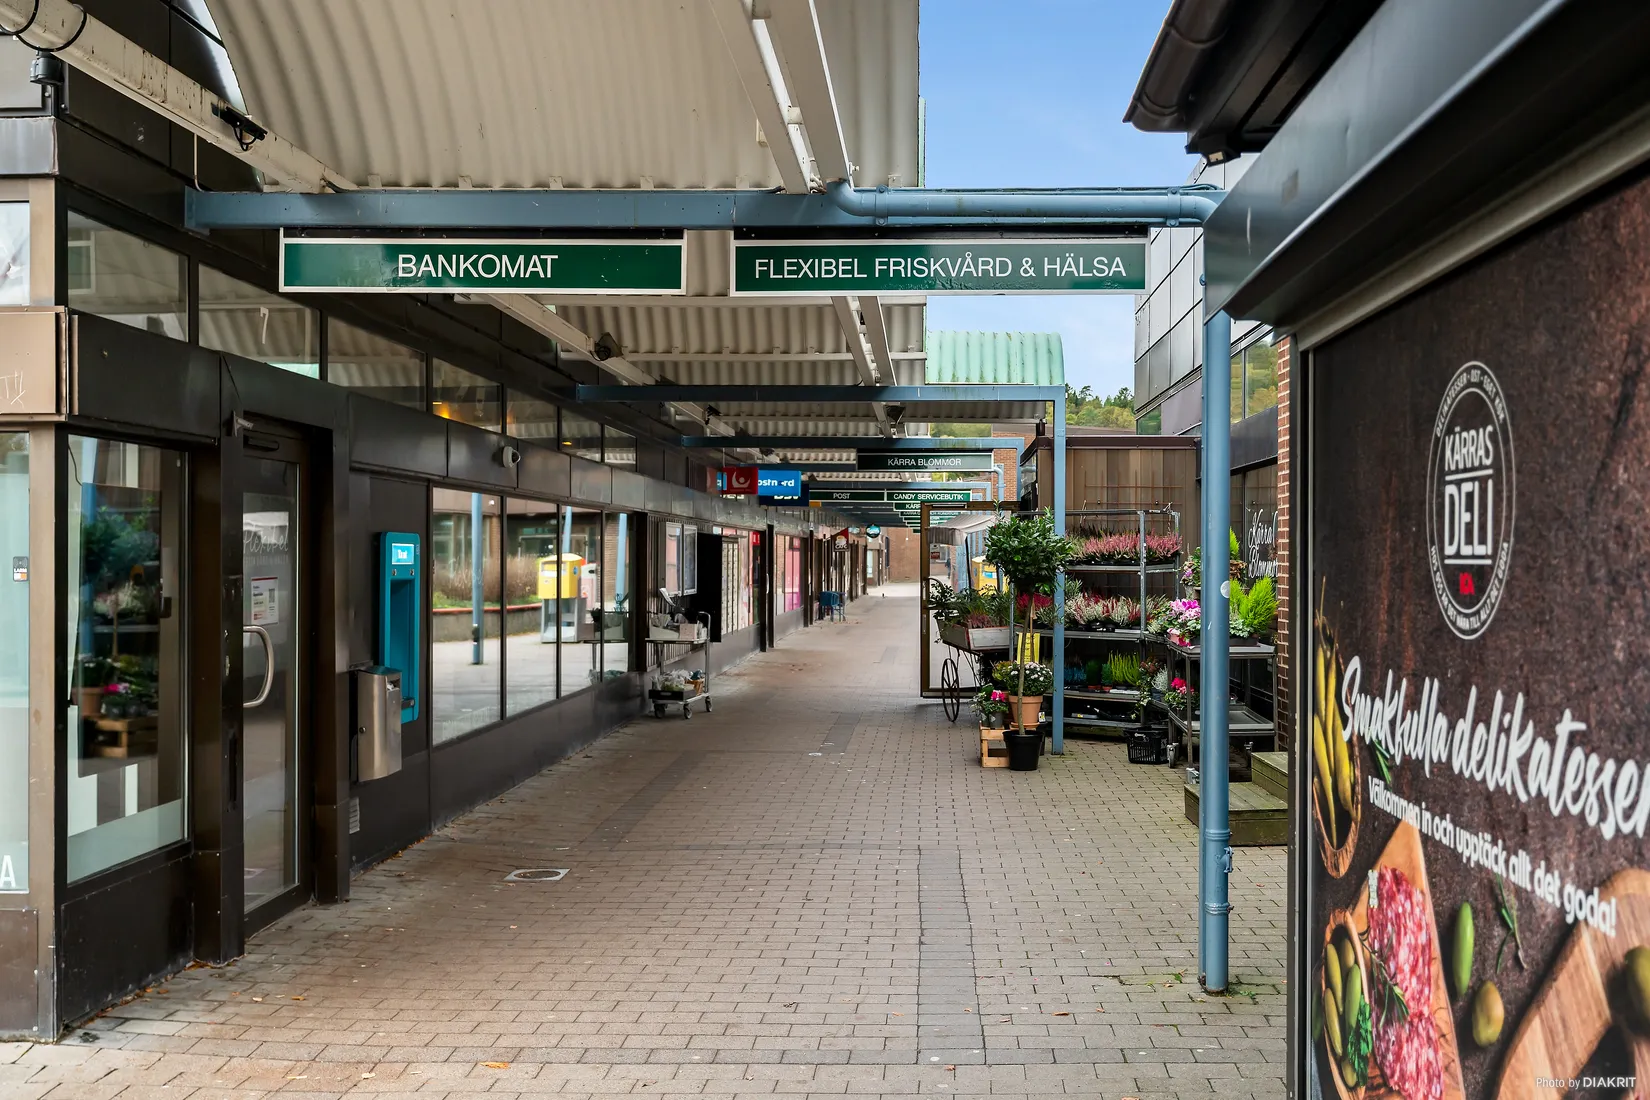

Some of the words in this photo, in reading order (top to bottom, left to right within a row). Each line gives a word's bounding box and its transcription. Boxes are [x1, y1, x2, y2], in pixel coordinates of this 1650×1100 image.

[398, 254, 558, 278] BANKOMAT
[755, 258, 867, 279] FLEXIBEL
[875, 252, 1012, 278] FRISKVÅRD
[1020, 257, 1036, 277] &
[1044, 253, 1126, 277] HÄLSA
[1436, 372, 1467, 437] DELIKATESSER
[1470, 369, 1481, 382] OST
[888, 457, 916, 466] KÄRRA
[918, 458, 962, 467] BLOMMOR
[1445, 425, 1493, 471] KÄRRAS
[1444, 479, 1493, 555] DELI
[1341, 655, 1451, 778] Smakfulla
[1368, 775, 1420, 830] Välkommen
[1421, 801, 1433, 836] in
[1433, 813, 1455, 849] och
[1456, 826, 1507, 877] upptäck
[1508, 849, 1532, 892] allt
[1534, 860, 1560, 908] det
[1563, 882, 1616, 937] goda!
